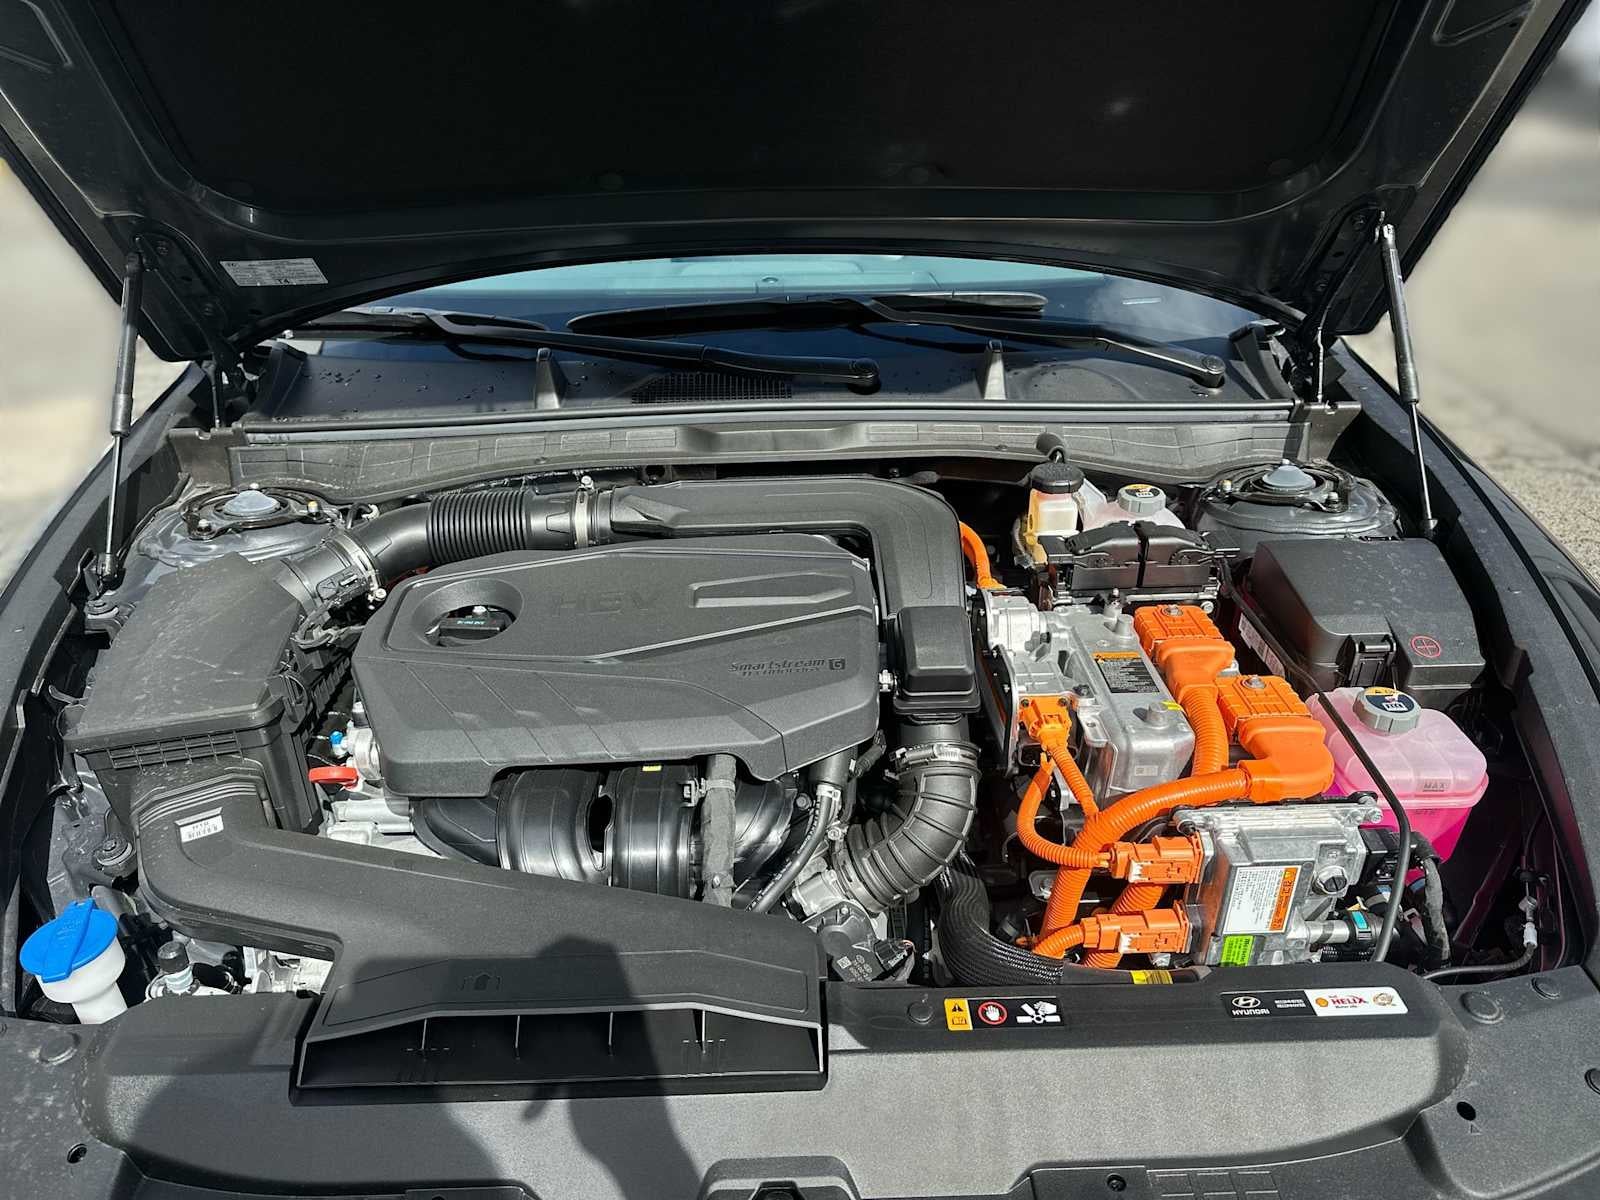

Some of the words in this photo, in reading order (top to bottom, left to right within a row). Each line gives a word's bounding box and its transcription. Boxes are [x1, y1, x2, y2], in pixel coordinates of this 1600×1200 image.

[728, 659, 825, 673] Smartstream
[1331, 998, 1366, 1006] HELIX
[1232, 1008, 1270, 1016] HYUNDAI
